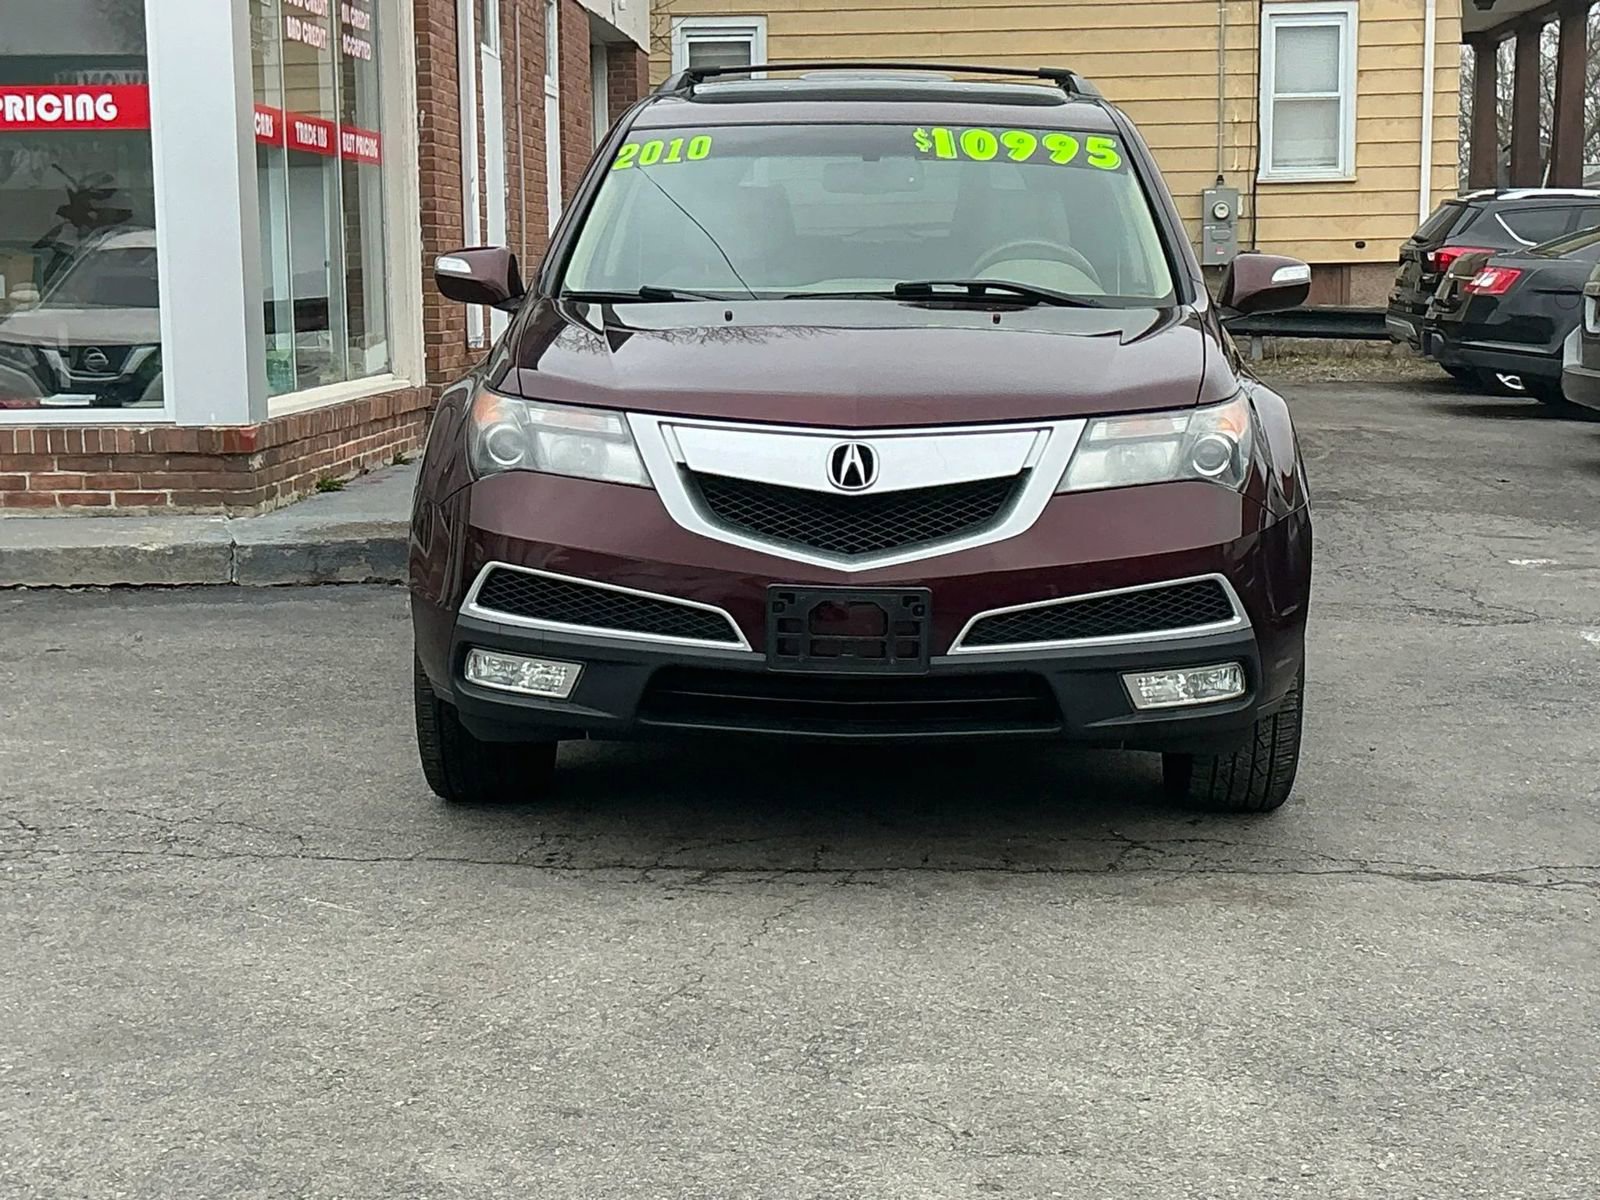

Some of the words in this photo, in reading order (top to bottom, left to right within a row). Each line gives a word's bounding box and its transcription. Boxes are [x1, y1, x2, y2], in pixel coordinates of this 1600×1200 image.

[287, 15, 301, 41] BAD
[302, 21, 326, 50] CREDIT
[350, 6, 370, 31] CREDIT
[343, 33, 371, 61] ACCEPTED
[0, 93, 118, 122] RICING
[254, 112, 273, 138] CARS
[295, 121, 317, 146] TRADE
[342, 131, 355, 154] BEST
[355, 134, 379, 159] PRICING
[612, 135, 712, 171] 2010
[913, 127, 1121, 171] $10995
